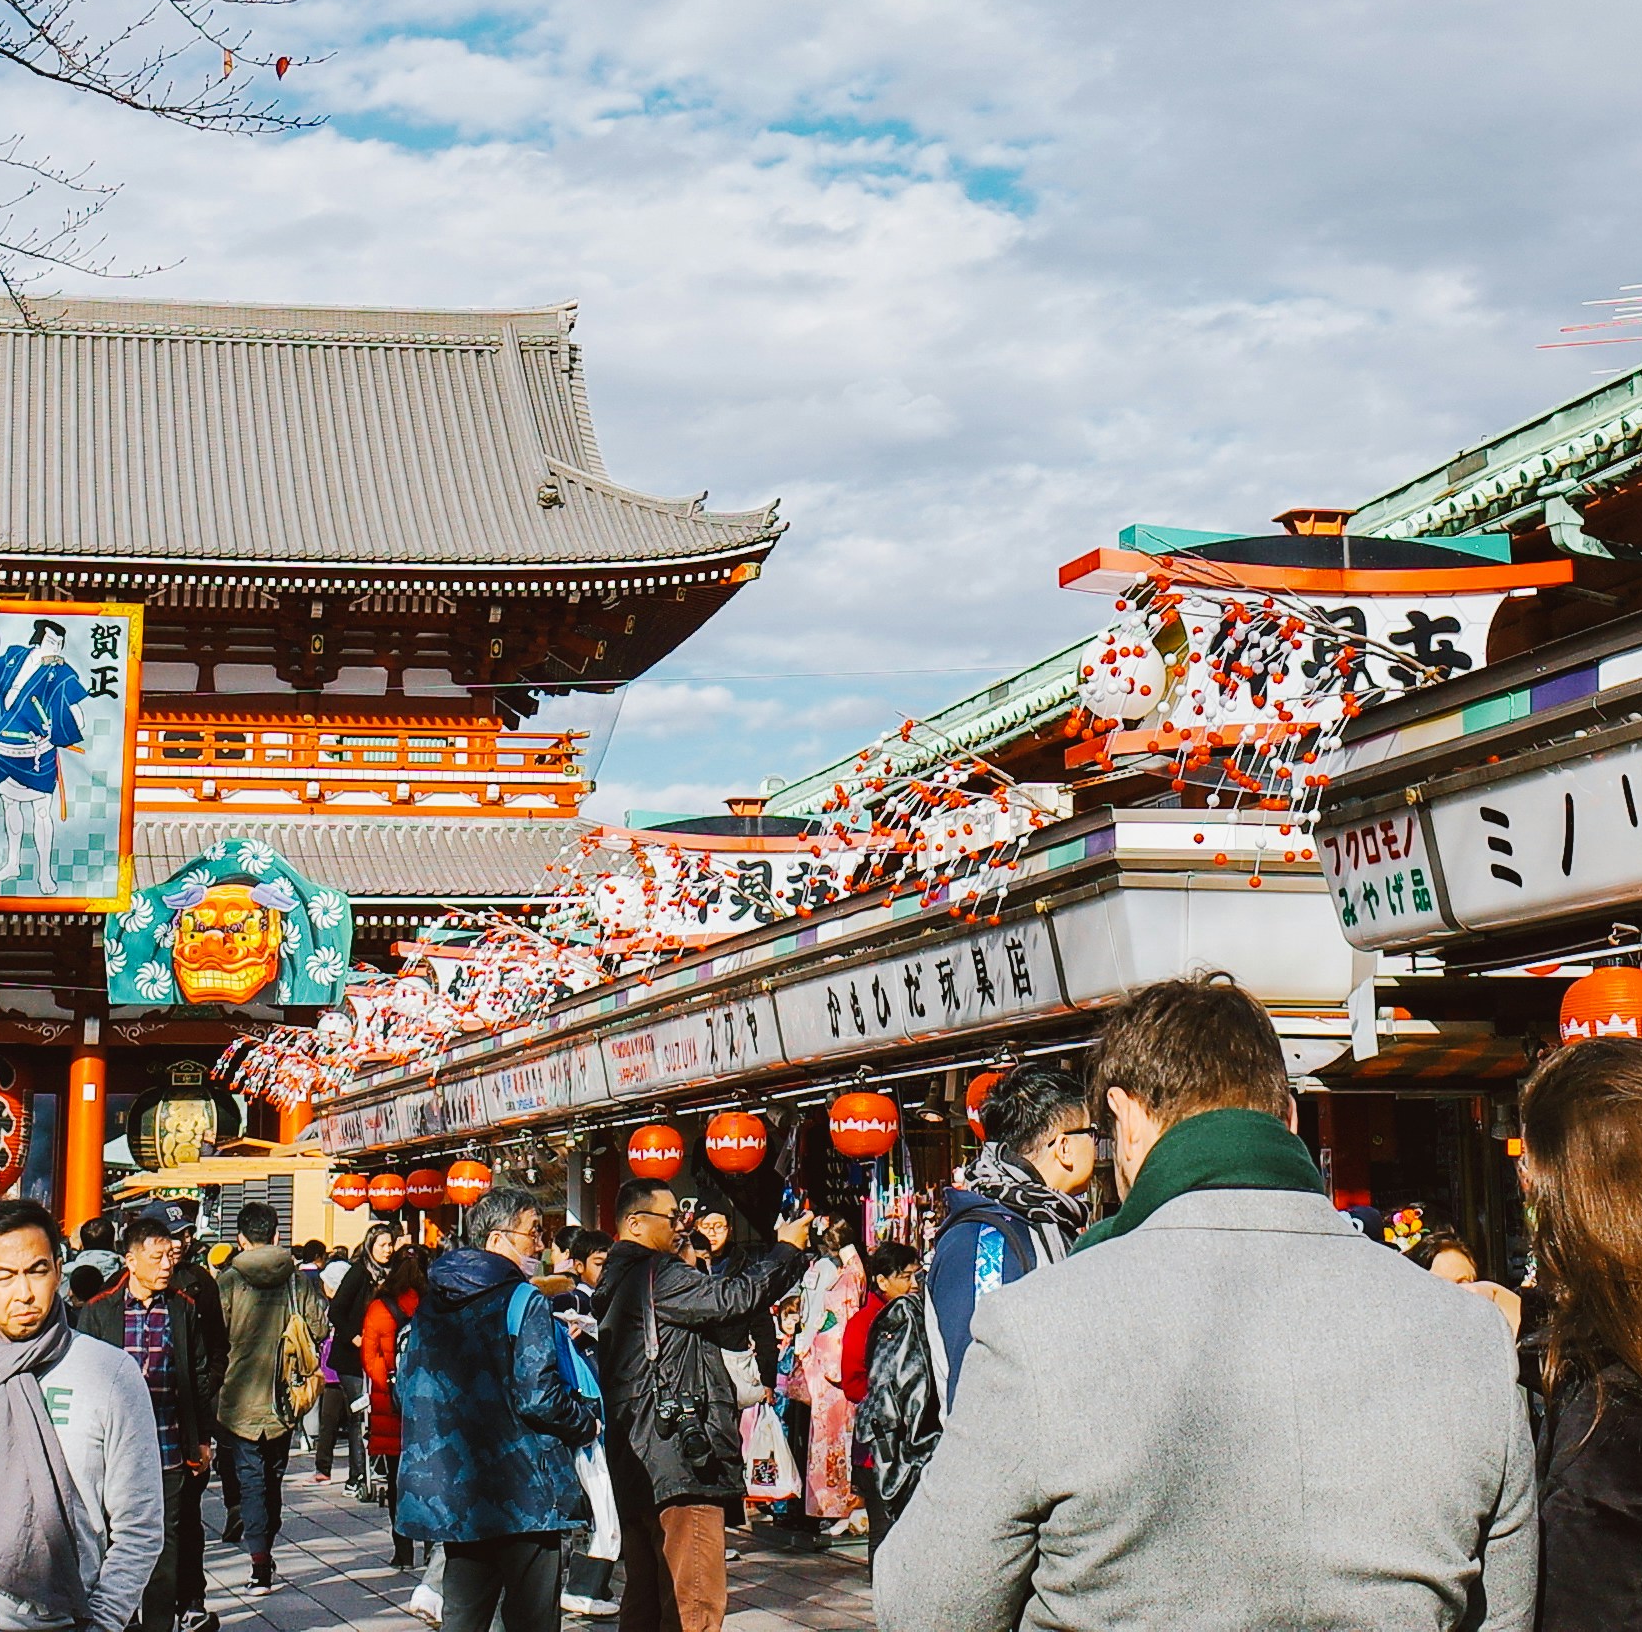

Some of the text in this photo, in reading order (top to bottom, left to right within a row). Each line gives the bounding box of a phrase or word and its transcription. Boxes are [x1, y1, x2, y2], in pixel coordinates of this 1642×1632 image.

[88, 623, 122, 699] 賀正
[1323, 816, 1414, 877] フクロモノ
[1338, 868, 1433, 927] みやげ品
